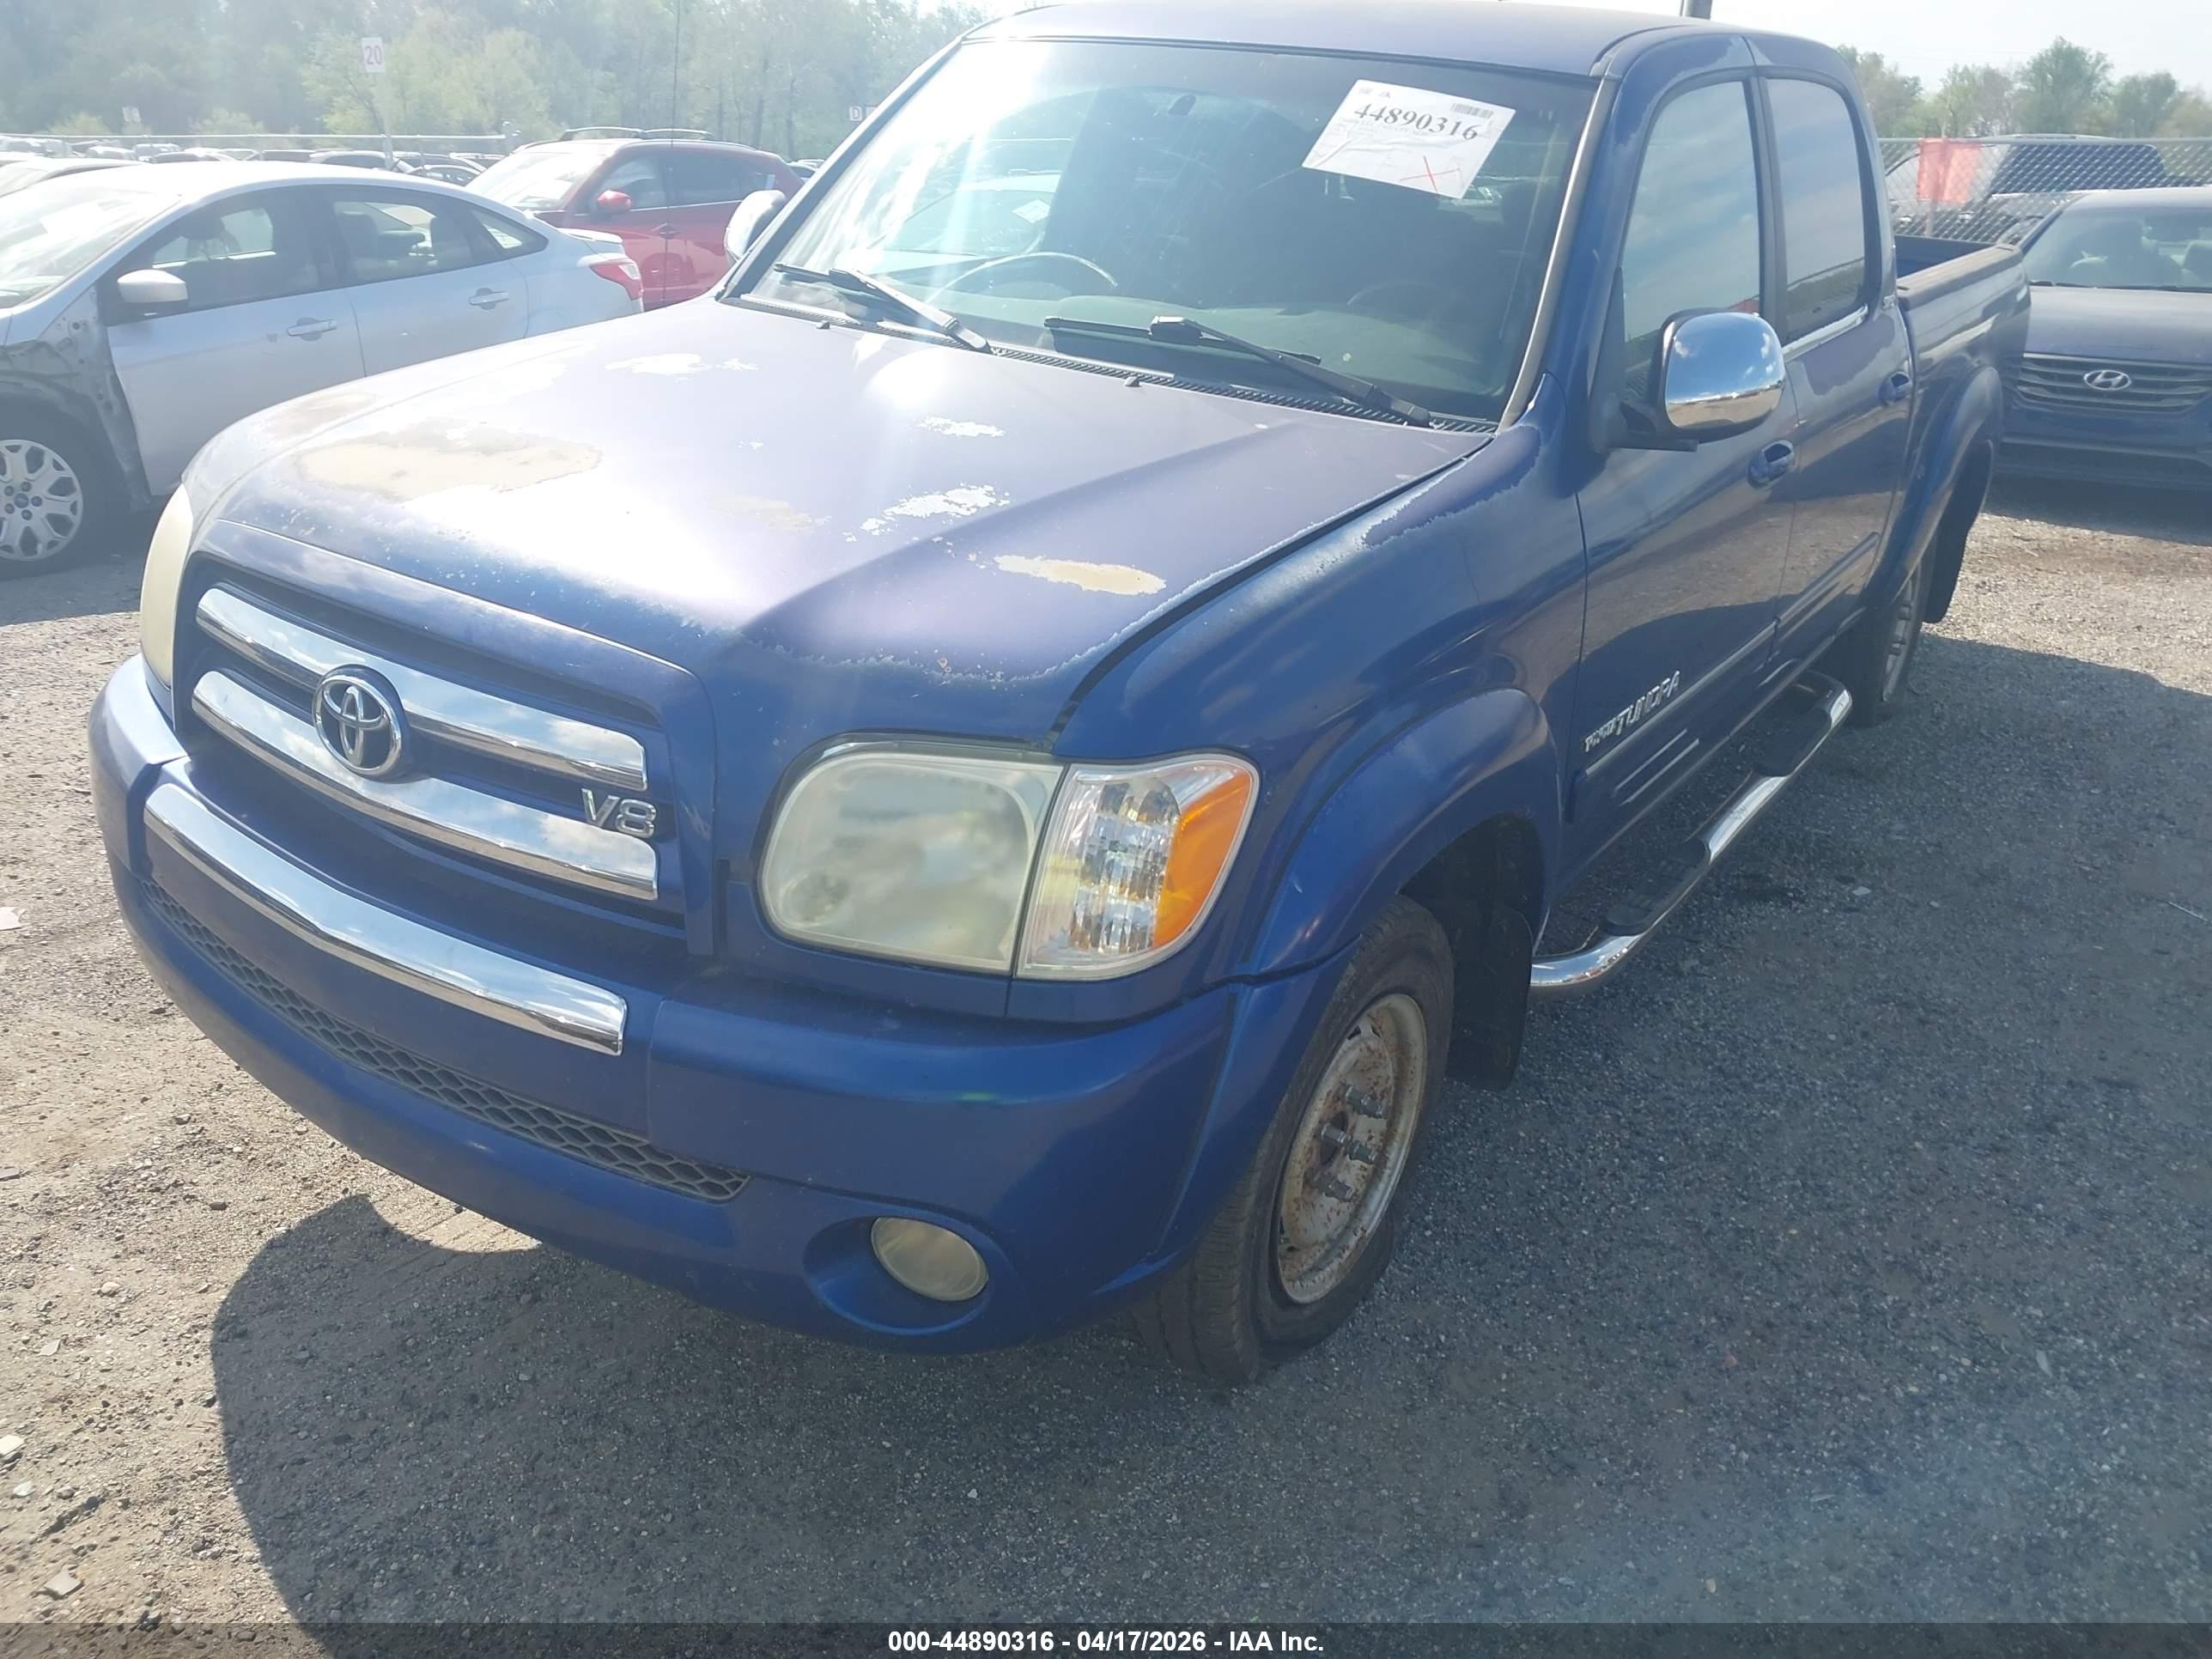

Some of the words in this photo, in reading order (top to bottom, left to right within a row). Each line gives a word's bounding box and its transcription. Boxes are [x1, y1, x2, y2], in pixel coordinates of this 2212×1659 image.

[364, 45, 383, 65] 20
[1354, 102, 1482, 141] 44890316
[1615, 670, 1680, 736] TUNDRA
[580, 787, 657, 839] V8
